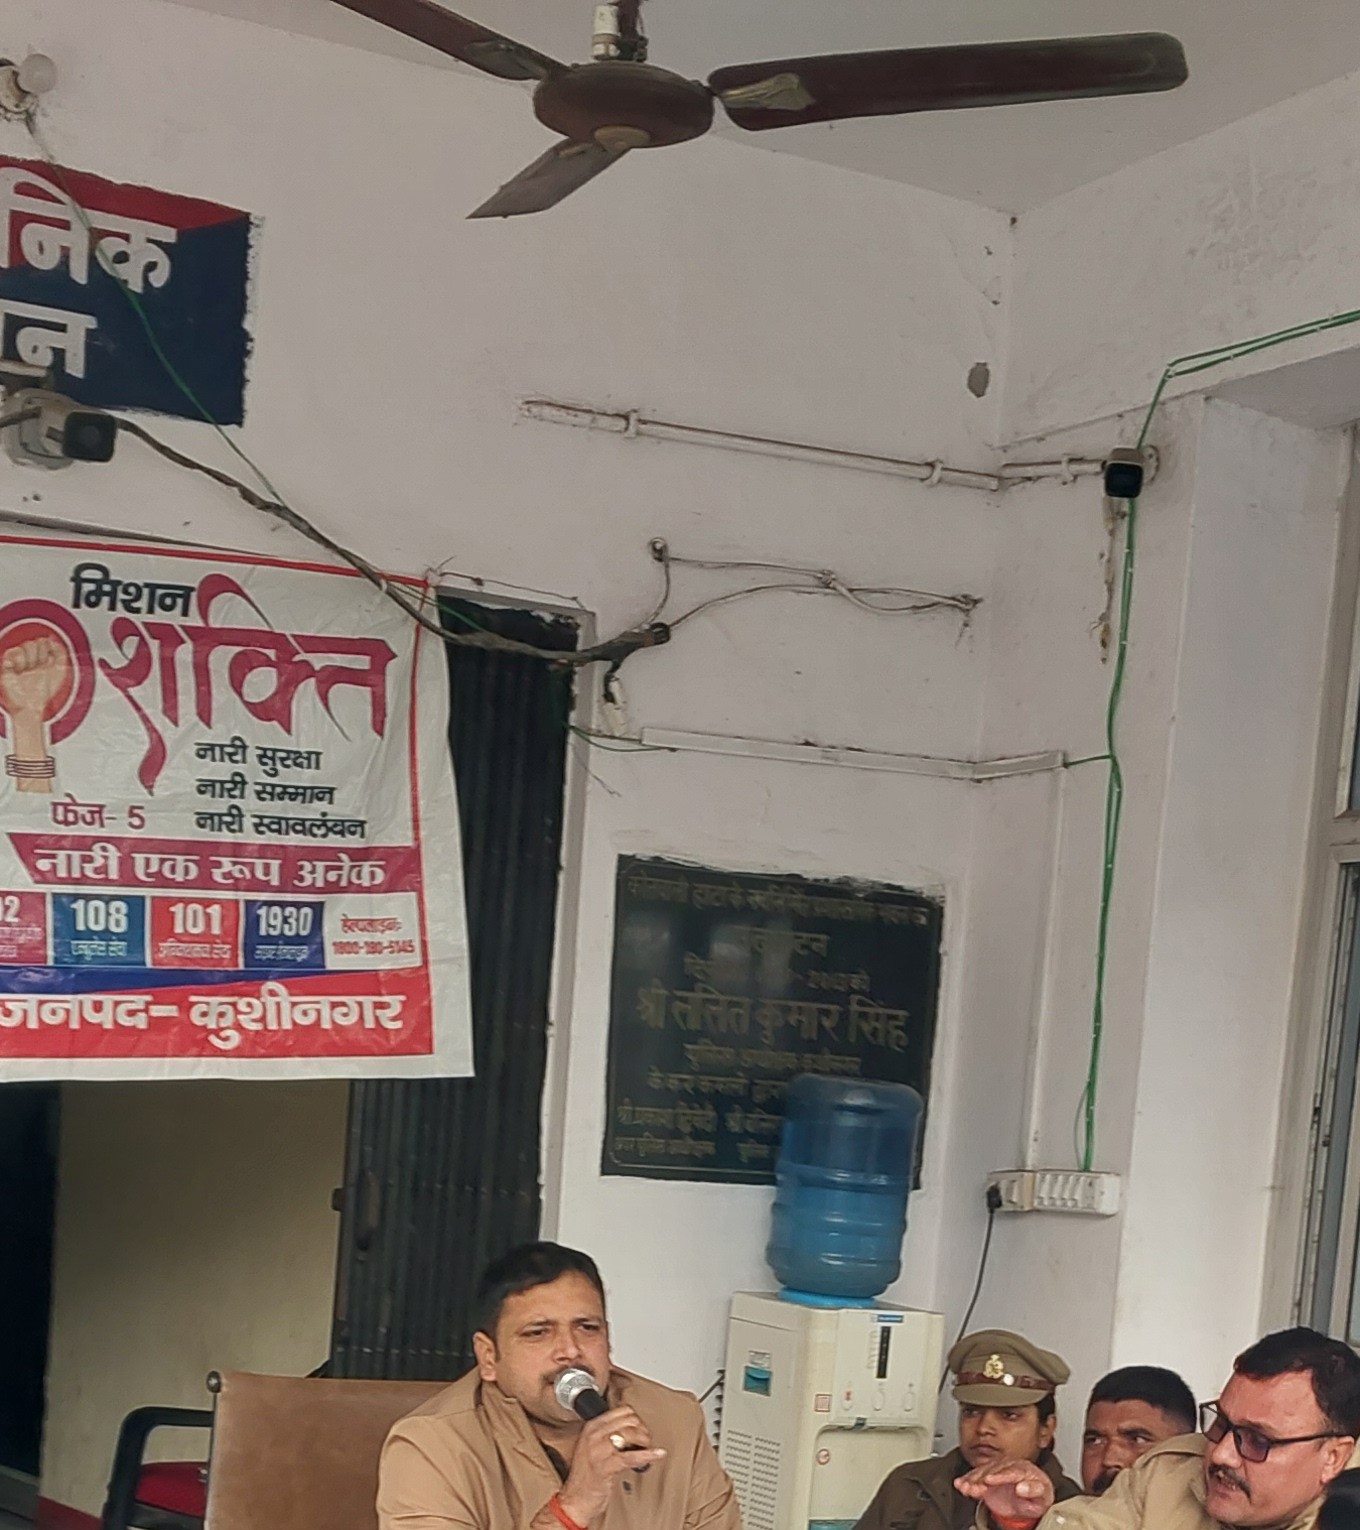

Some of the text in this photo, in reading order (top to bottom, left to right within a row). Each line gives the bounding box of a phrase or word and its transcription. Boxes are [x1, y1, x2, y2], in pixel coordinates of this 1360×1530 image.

[70, 562, 196, 617] मिशन
[96, 572, 398, 797] शक्ति
[195, 736, 321, 778] नारी सुरक्षा
[195, 771, 336, 806] नारी सम्मान
[127, 805, 146, 829] 5
[195, 805, 243, 835] नारी
[33, 841, 386, 888] नारी एक रूप अनेक
[69, 898, 128, 934] 108
[169, 903, 223, 935] 101
[256, 905, 311, 937] 1930
[188, 981, 407, 1050] कुशीनगर
[753, 1000, 842, 1046] कुमार
[848, 995, 910, 1053] सिंह
